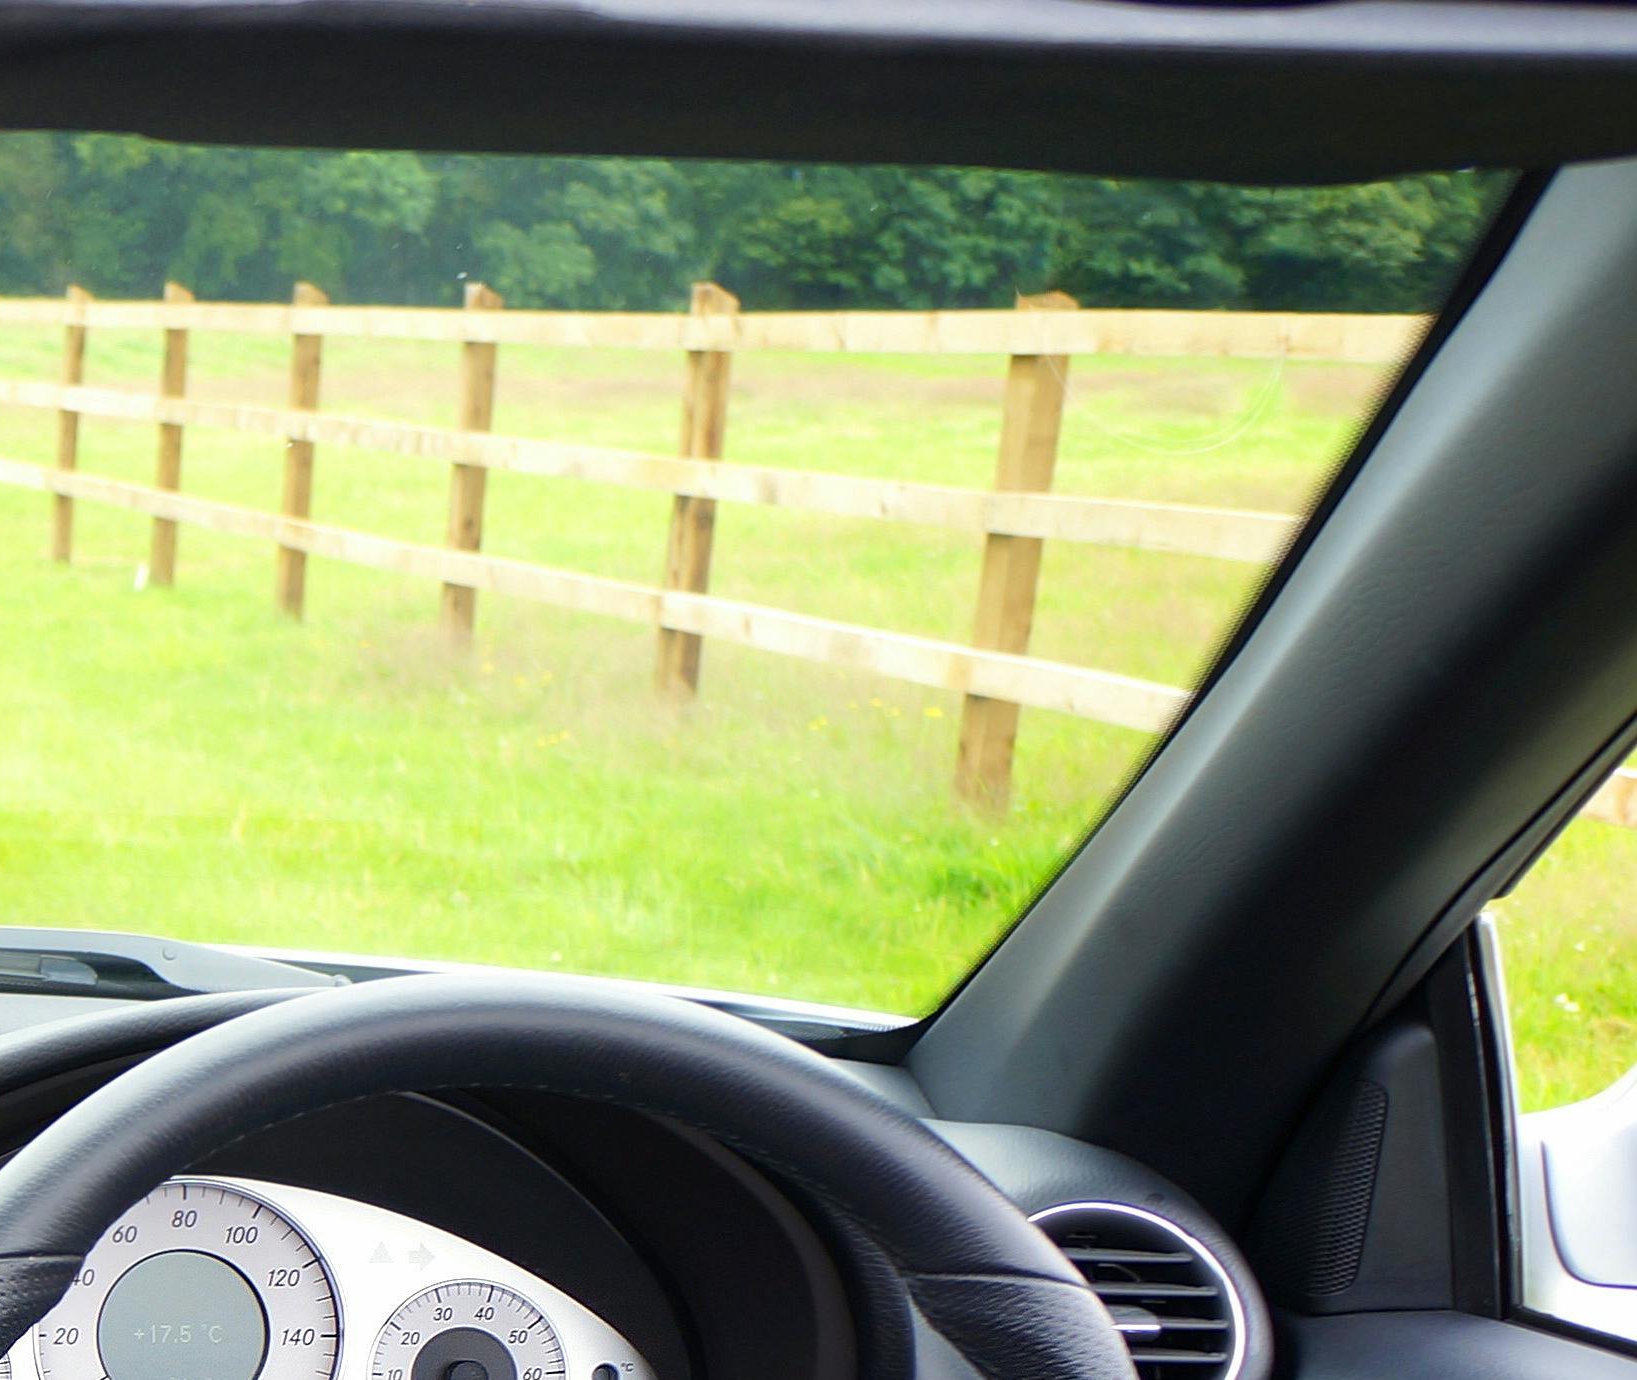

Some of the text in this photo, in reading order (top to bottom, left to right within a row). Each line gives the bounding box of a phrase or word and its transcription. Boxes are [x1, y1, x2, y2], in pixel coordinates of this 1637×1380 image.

[171, 1210, 197, 1228] 80
[112, 1225, 137, 1243] 60
[225, 1226, 258, 1244] 100
[267, 1269, 300, 1287] 120
[433, 1307, 452, 1321] 30
[475, 1307, 494, 1321] 40
[53, 1327, 79, 1345] 20
[133, 1325, 192, 1343] +17.5
[281, 1328, 315, 1346] 140
[401, 1332, 420, 1345] 20
[508, 1330, 528, 1344] 50
[523, 1368, 542, 1380] 60
